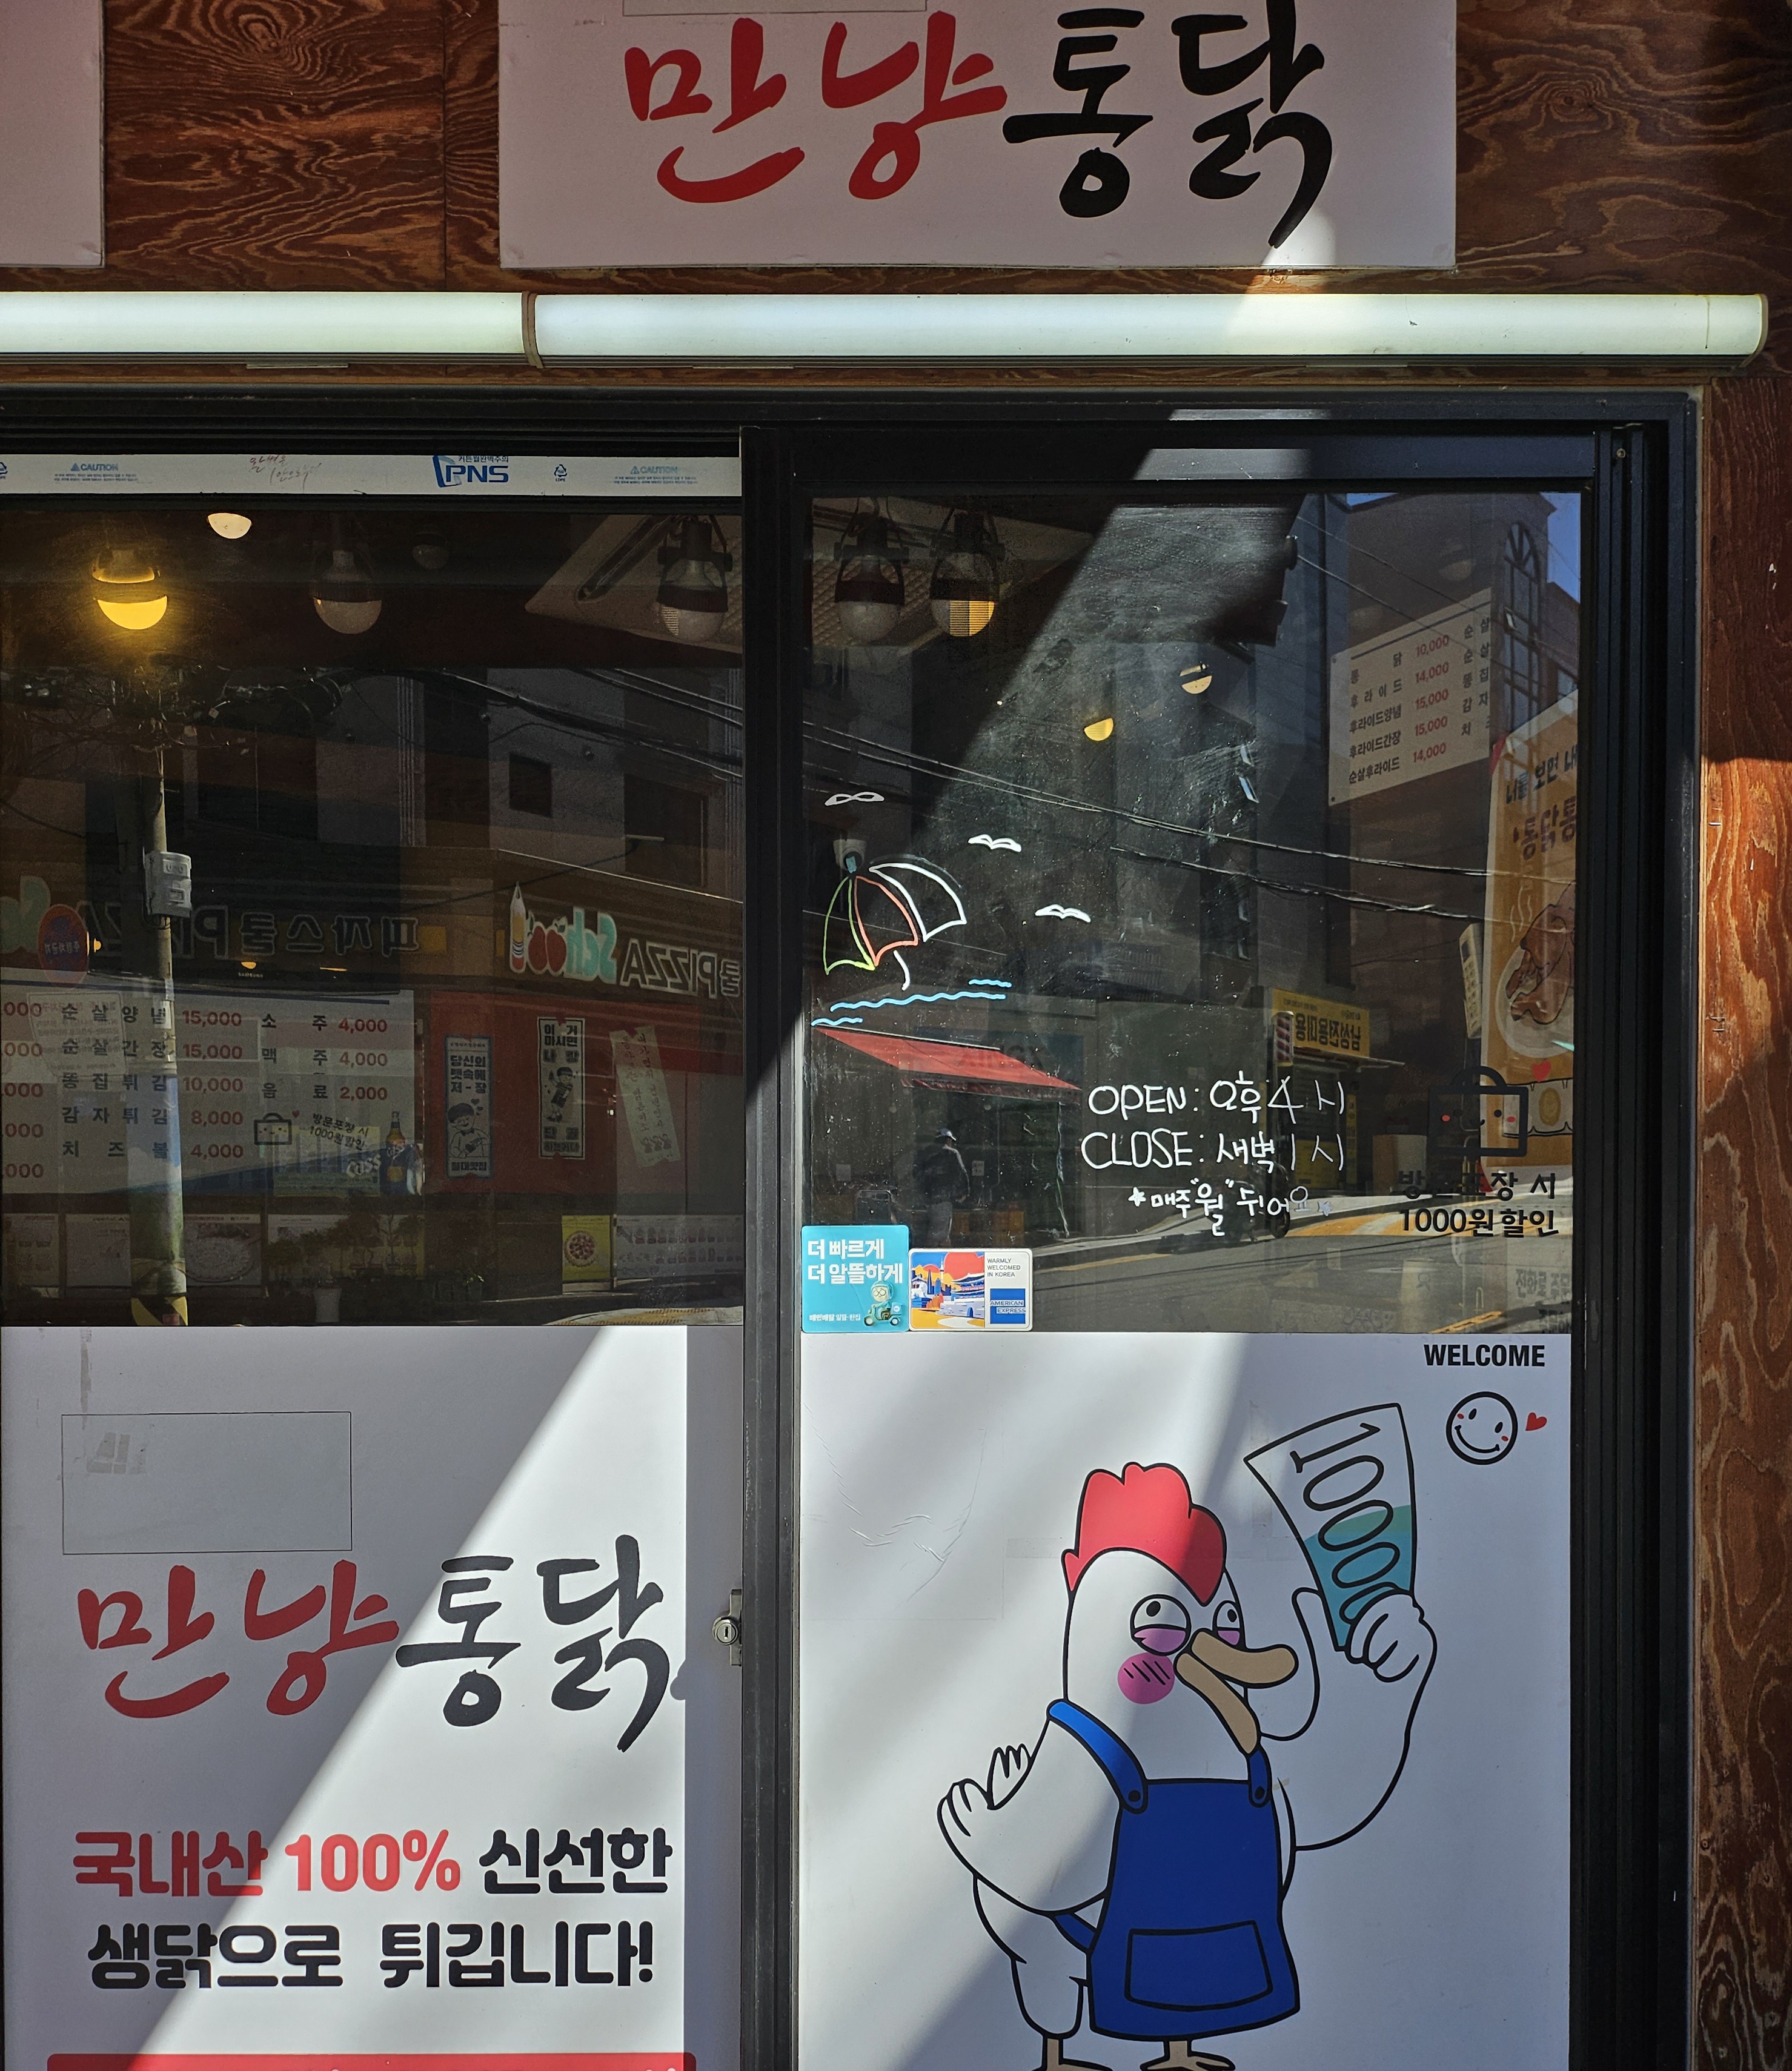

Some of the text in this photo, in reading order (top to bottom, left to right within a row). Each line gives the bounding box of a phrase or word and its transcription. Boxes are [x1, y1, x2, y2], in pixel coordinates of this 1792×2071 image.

[446, 465, 508, 483] PNS
[1416, 635, 1450, 657] 10,000
[1416, 662, 1450, 683] 14,000
[1349, 704, 1401, 733] 후라이드양념
[1415, 689, 1449, 710] 15,000
[1350, 730, 1401, 758] 후라이드간장
[1415, 715, 1448, 737] 15,000
[1349, 757, 1400, 784] 순살후라이드
[1413, 742, 1447, 762] 14,000
[1533, 752, 1559, 790] 보면
[182, 1010, 242, 1027] 15,000
[338, 1019, 388, 1033] 4,000
[544, 1035, 577, 1047] 마시면
[182, 1044, 243, 1060] 15,000
[339, 1052, 388, 1067] 4,000
[450, 1055, 486, 1067] 당신의
[183, 1078, 244, 1094] 10,000
[340, 1087, 388, 1101] 2,000
[191, 1110, 244, 1127] 8,000
[313, 1113, 356, 1133] 방문포장
[190, 1144, 244, 1159] 4,000
[808, 1238, 884, 1260] 더 빠르게
[808, 1262, 903, 1284] 더 알뜰하게
[1424, 1344, 1545, 1367] WELCOME
[73, 1826, 673, 1897] 국내산 100% 신선한
[87, 1921, 654, 1989] 생닭으로 튀깁니다!
